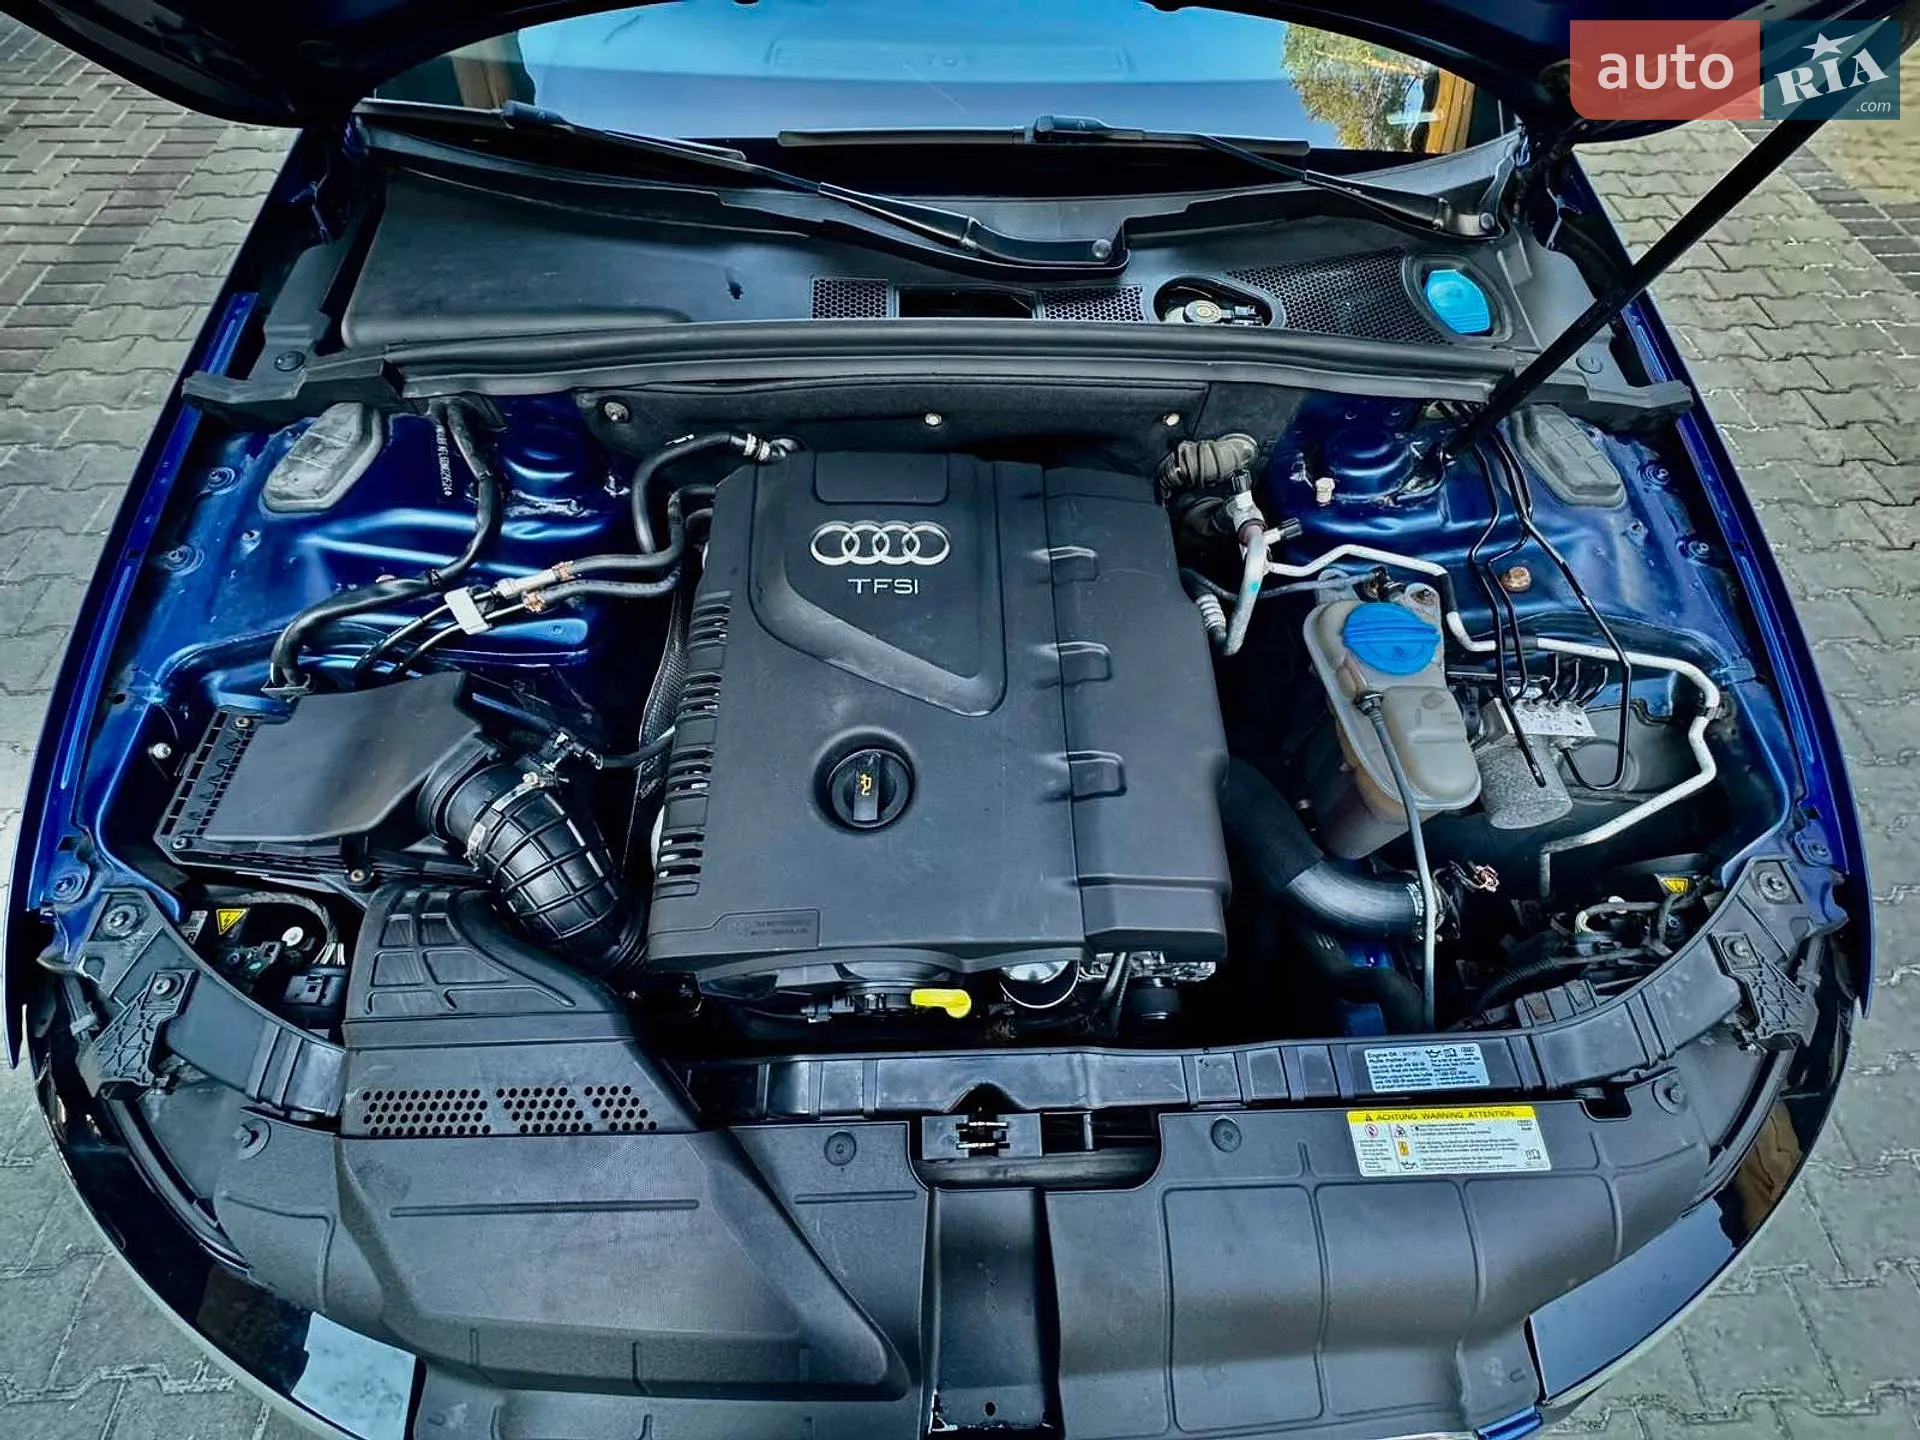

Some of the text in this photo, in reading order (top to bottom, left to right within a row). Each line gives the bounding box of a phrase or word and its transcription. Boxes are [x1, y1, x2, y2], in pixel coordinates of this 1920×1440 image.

[847, 578, 918, 595] TFSI
[1376, 1109, 1516, 1121] ACHTUNG WARNING ATTENTION
